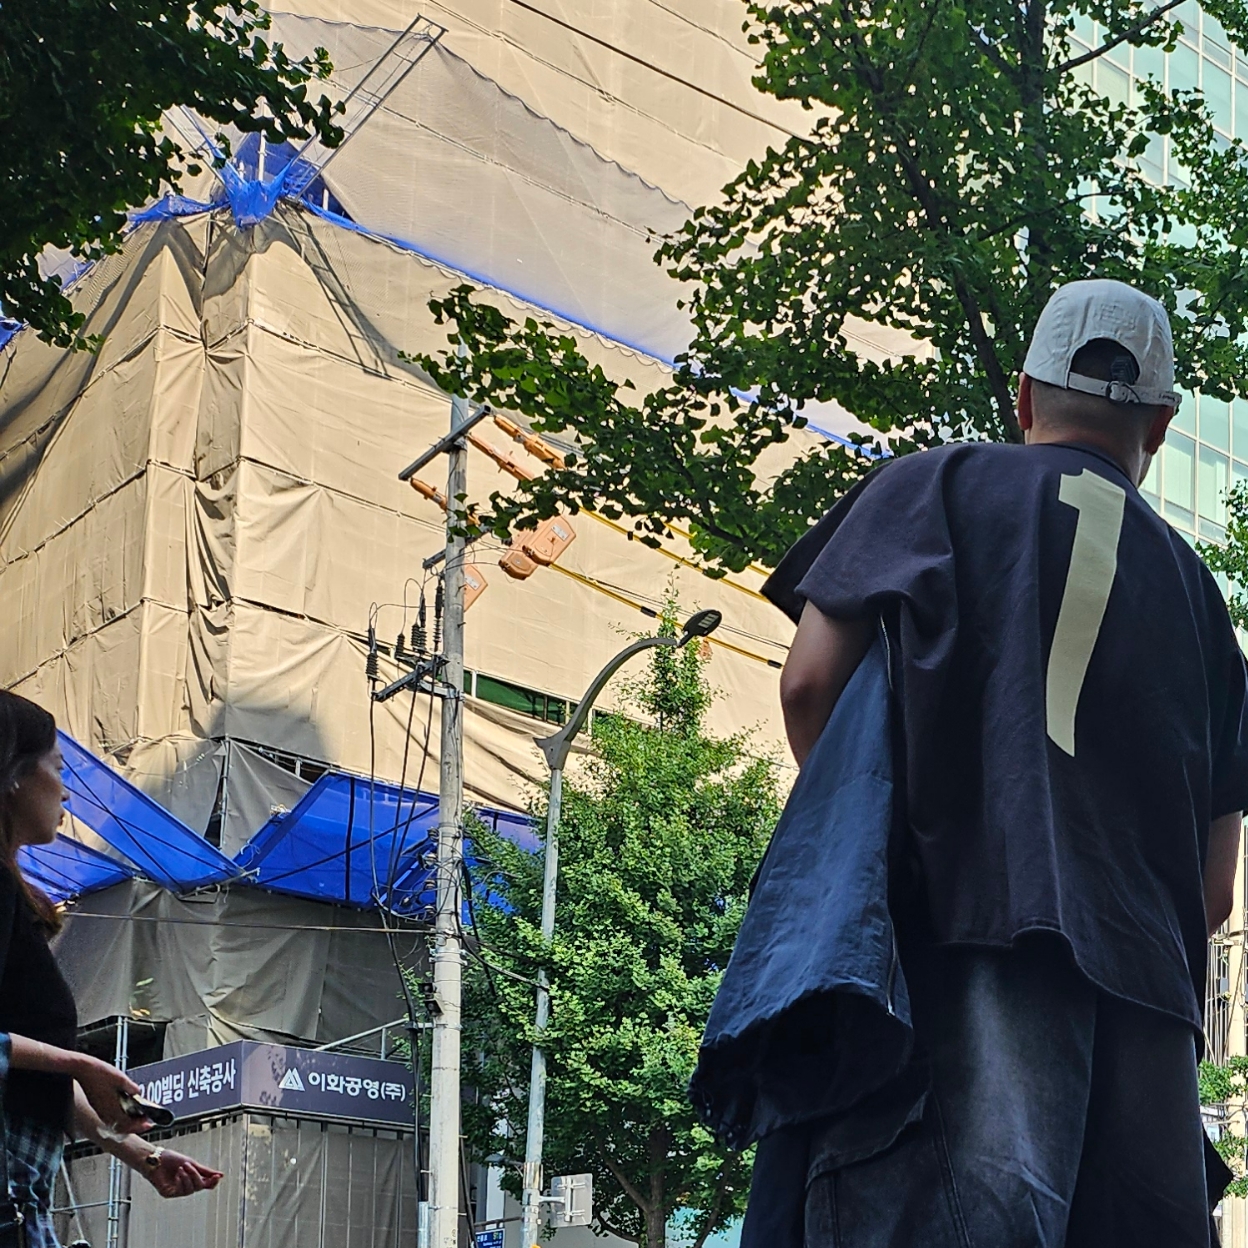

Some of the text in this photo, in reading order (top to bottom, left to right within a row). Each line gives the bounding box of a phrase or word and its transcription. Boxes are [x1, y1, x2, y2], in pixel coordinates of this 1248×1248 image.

[1046, 468, 1126, 757] 1
[187, 1060, 236, 1099] 신축공사
[308, 1071, 406, 1102] 이화공영(주)
